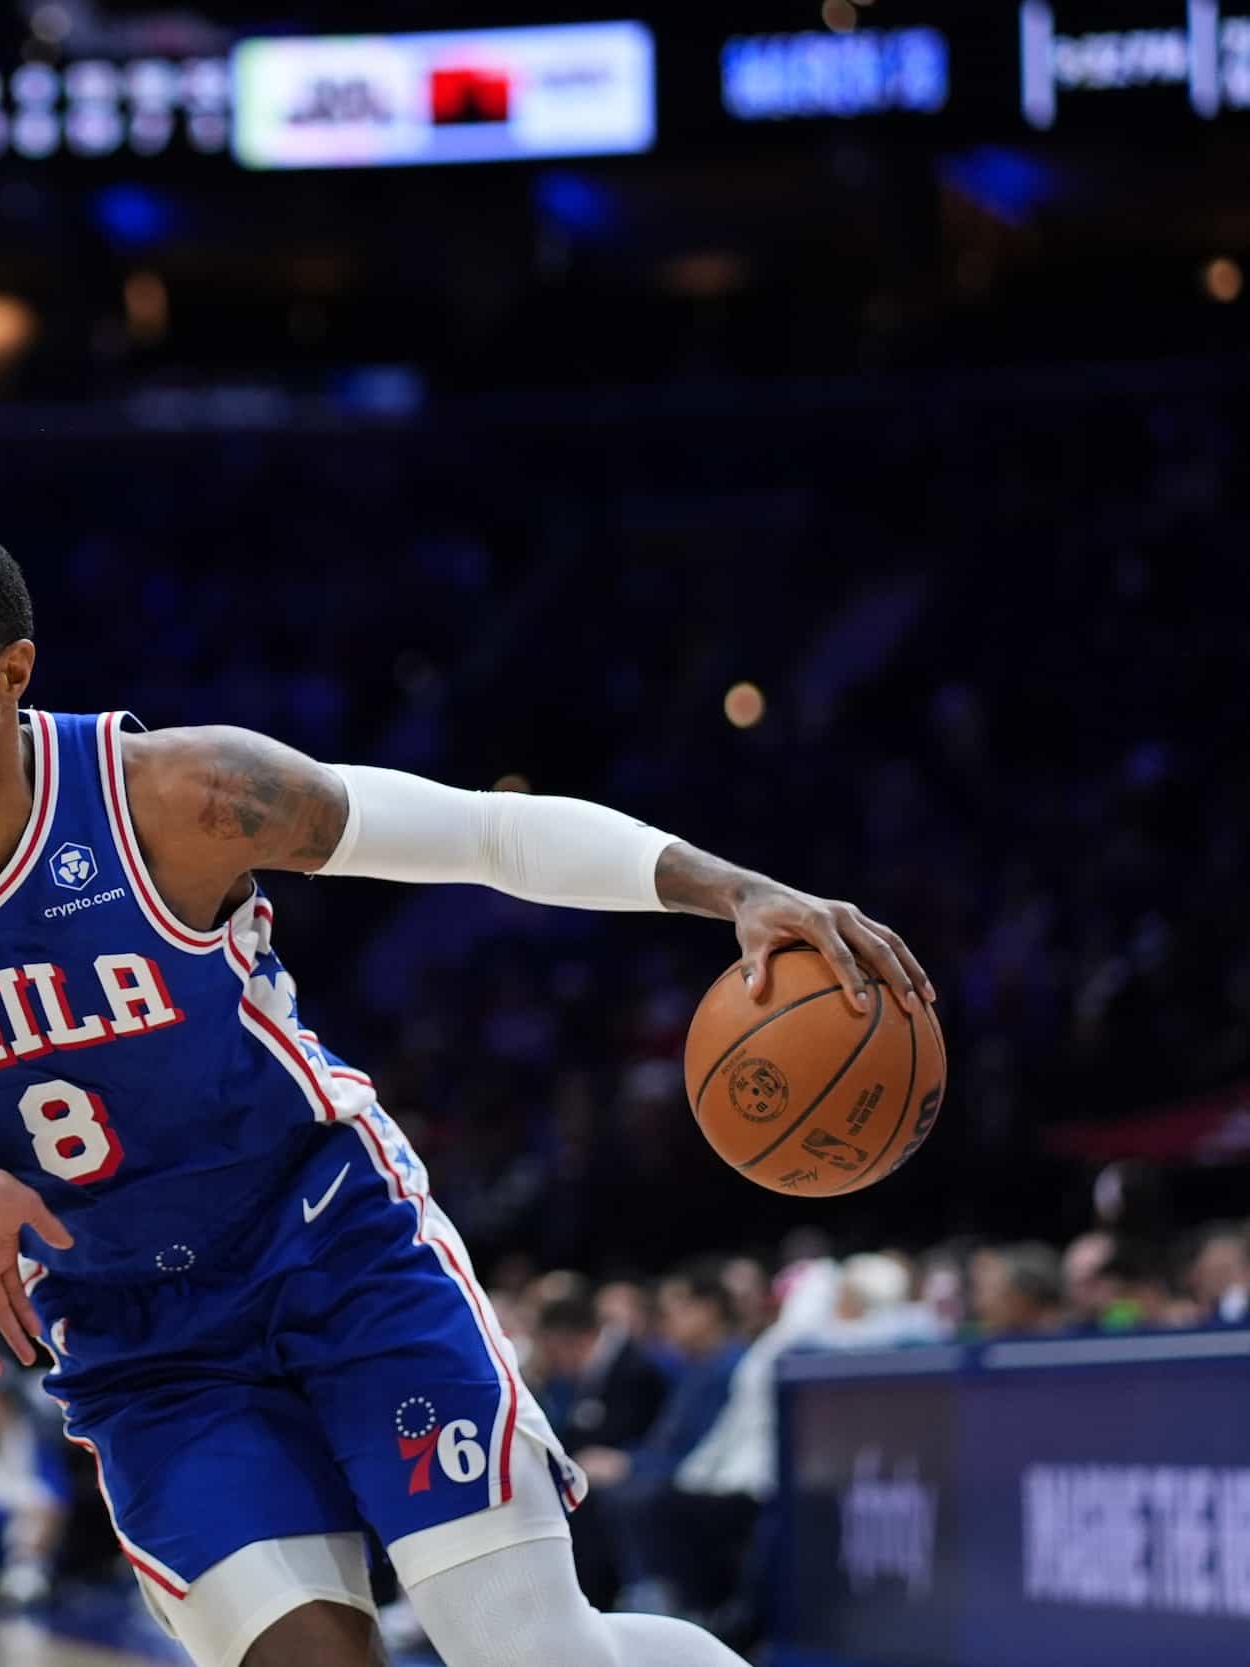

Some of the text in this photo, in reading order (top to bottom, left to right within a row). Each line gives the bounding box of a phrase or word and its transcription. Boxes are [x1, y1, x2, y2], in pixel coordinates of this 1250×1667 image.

[44, 887, 126, 918] crypto.com
[18, 1079, 125, 1185] 8
[397, 1419, 487, 1496] 76
